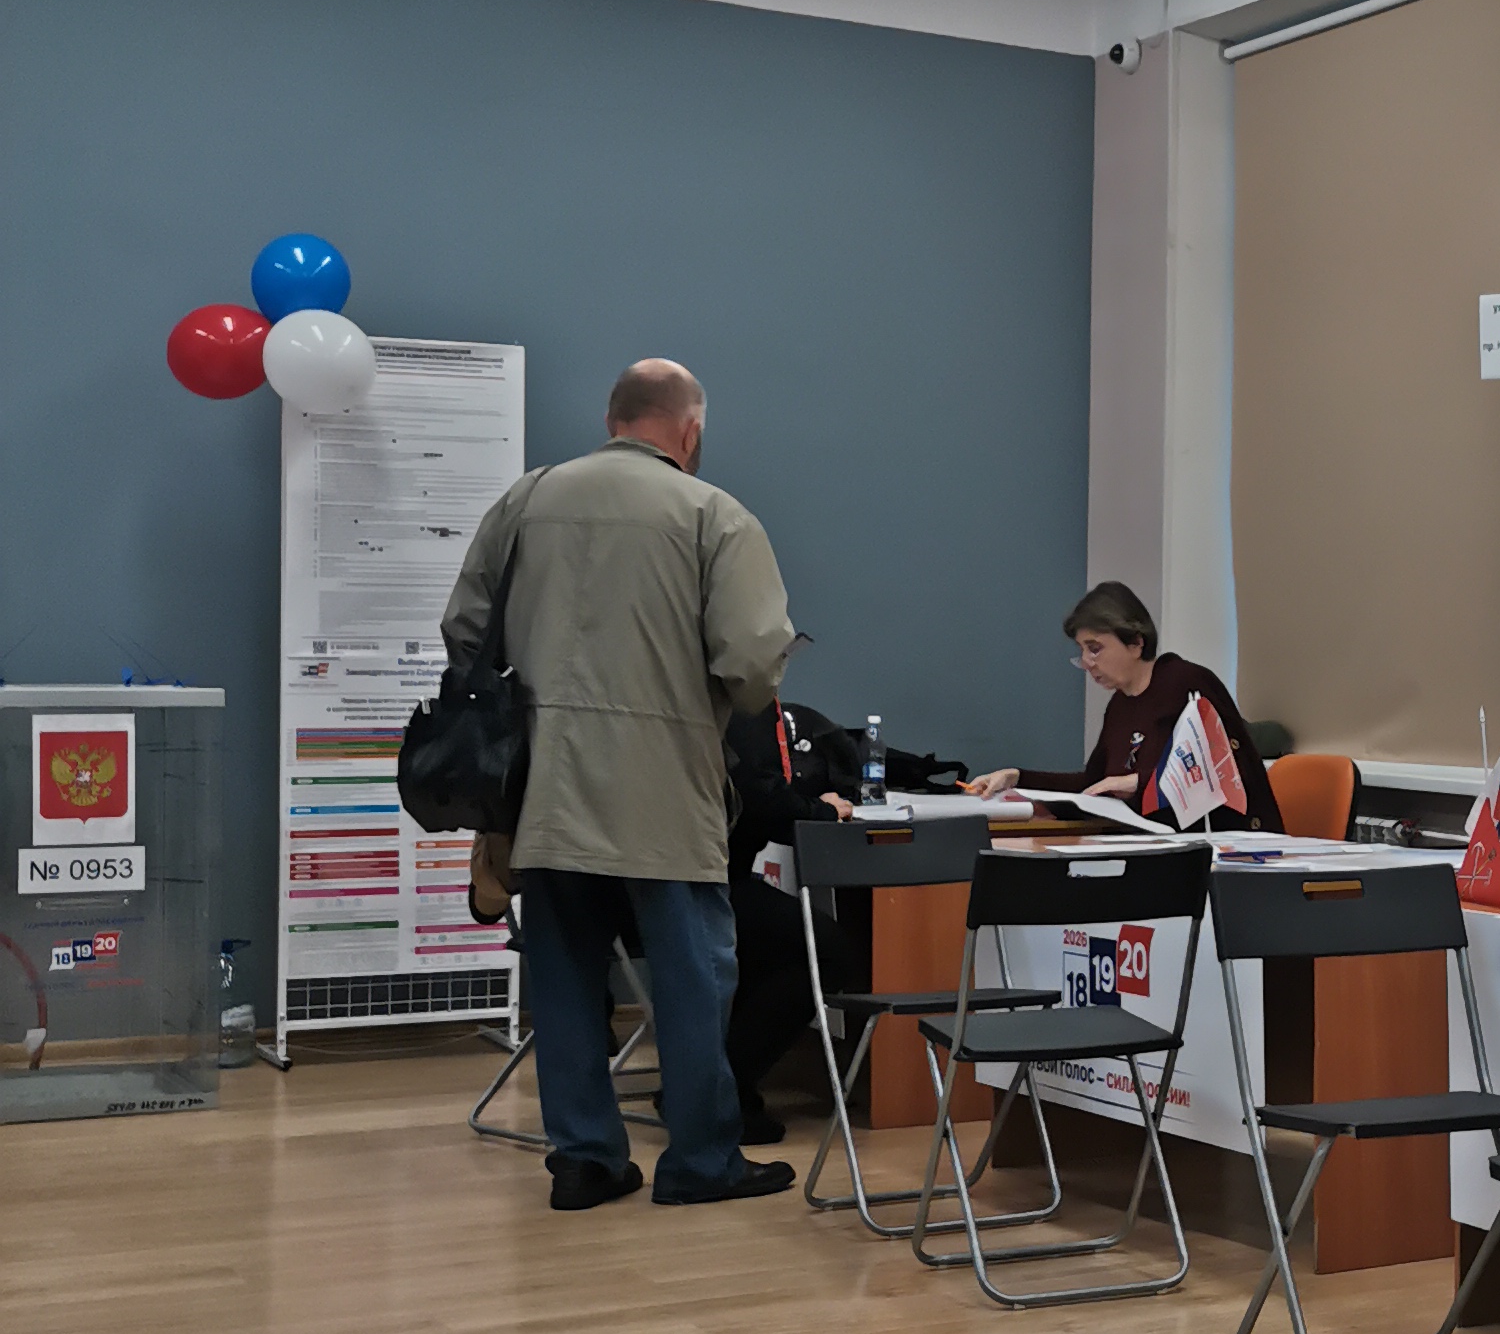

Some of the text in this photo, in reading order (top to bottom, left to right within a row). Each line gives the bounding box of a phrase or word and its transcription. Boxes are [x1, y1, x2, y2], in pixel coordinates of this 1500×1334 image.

[70, 858, 134, 881] 0953
[54, 936, 116, 965] 18 19 20
[1063, 928, 1087, 948] 2026
[1066, 939, 1147, 1007] 18 19 20
